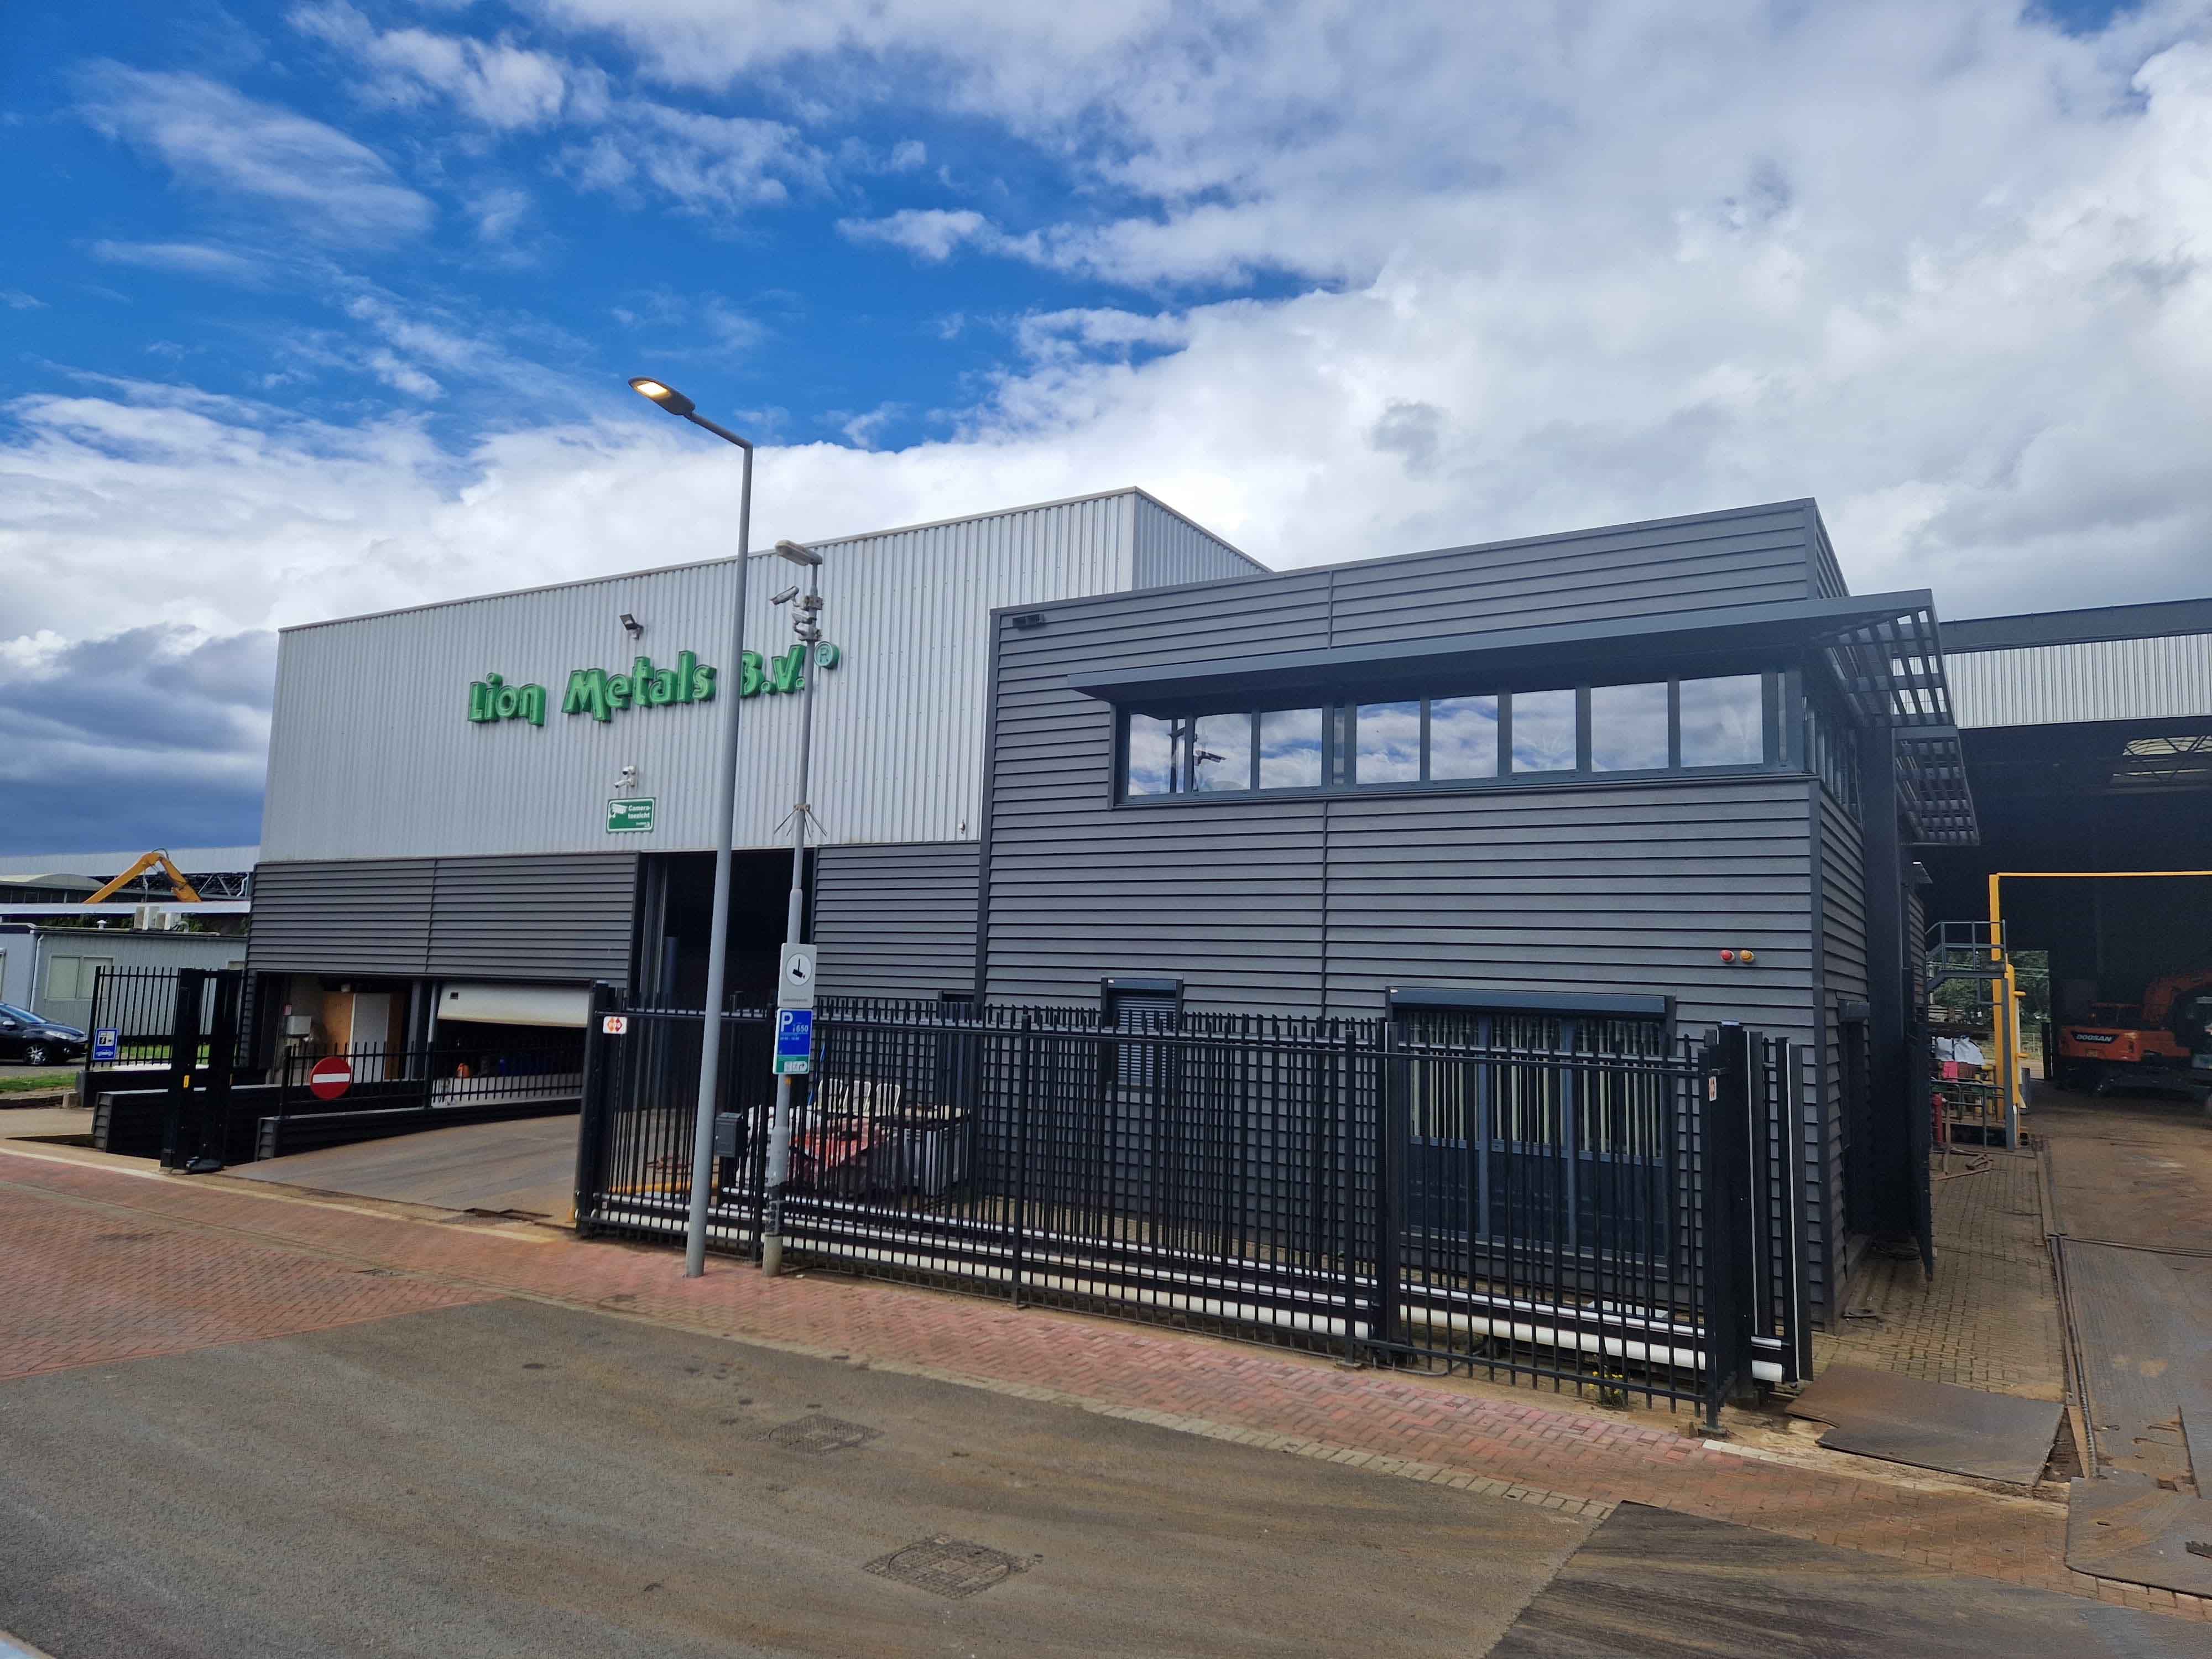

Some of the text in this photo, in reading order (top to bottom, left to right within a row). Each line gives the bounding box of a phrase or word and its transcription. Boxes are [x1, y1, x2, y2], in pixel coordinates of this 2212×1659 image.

[468, 672, 546, 726] Lion
[561, 650, 717, 722] Metals
[780, 1012, 793, 1032] P
[2076, 1034, 2112, 1042] DOOSAN
